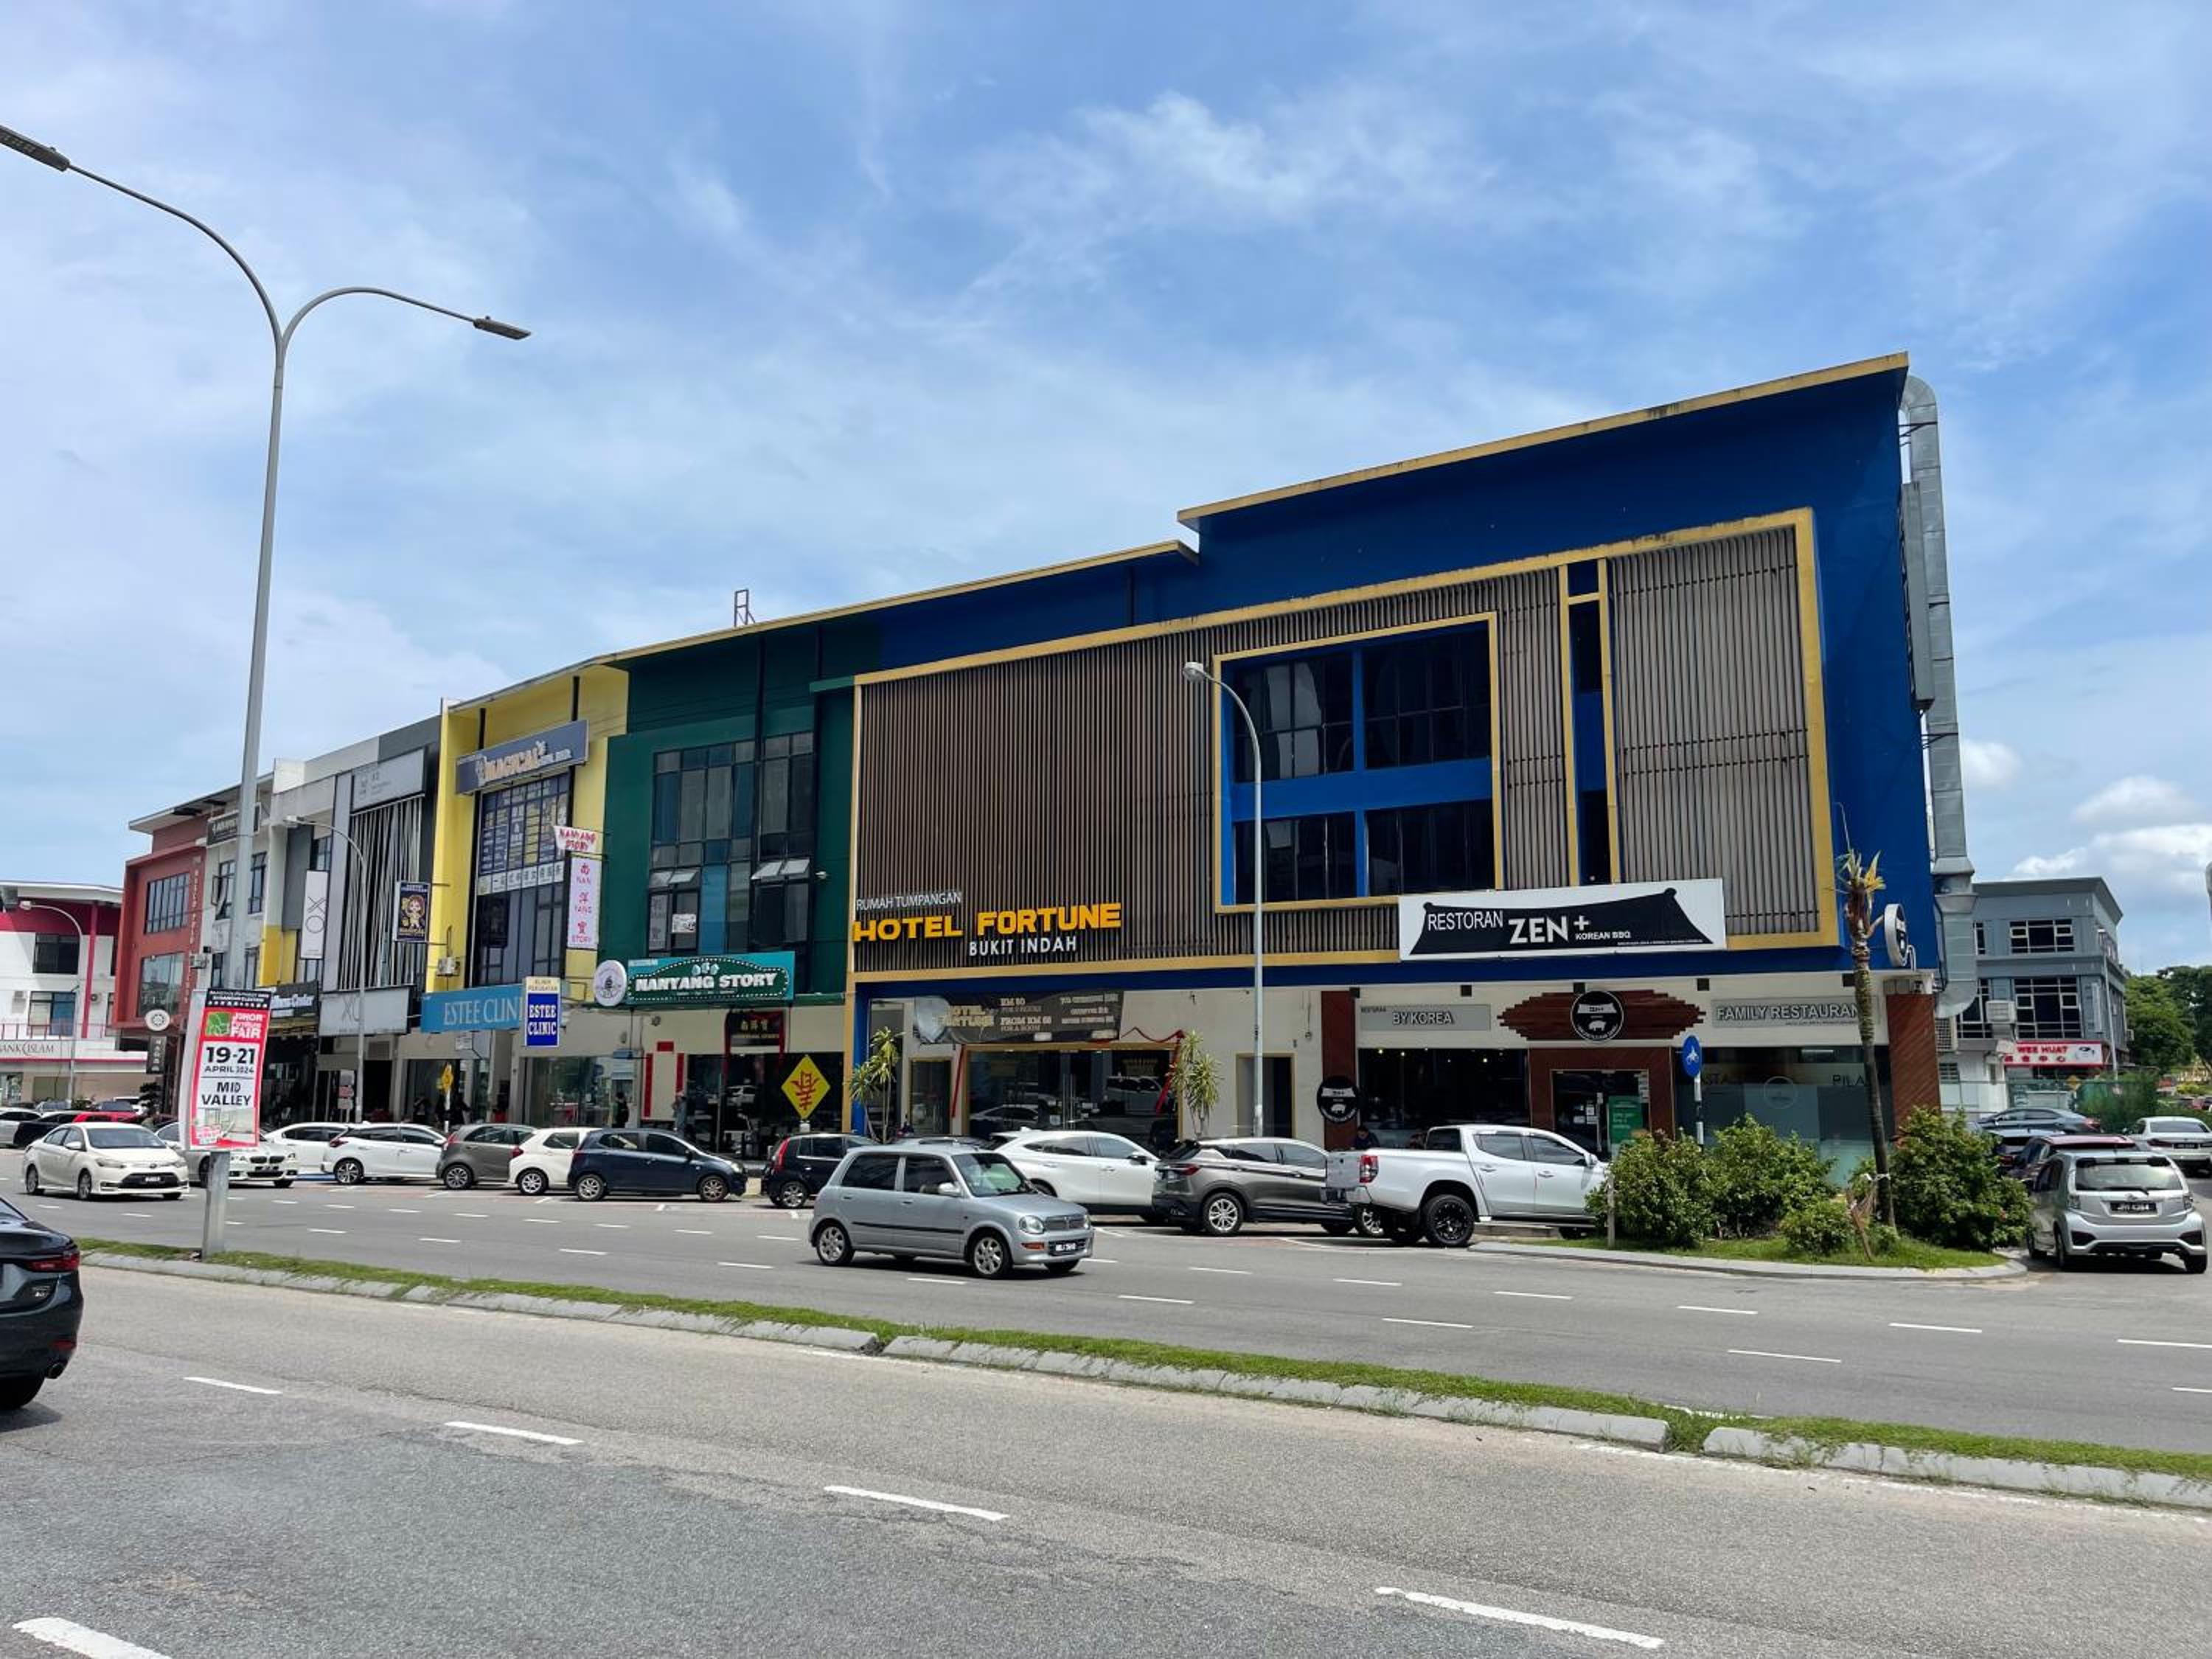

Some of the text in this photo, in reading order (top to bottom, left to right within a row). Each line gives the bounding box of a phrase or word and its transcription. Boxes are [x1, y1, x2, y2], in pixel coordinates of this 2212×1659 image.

[856, 891, 961, 911] RUMAH TUMPANGAN
[852, 902, 1121, 942] HOTEL FORTUNE
[1427, 911, 1503, 931] RESTORAN
[1575, 931, 1610, 940] KOREAN
[969, 936, 1077, 956] BUKIT INDAH
[635, 975, 714, 991] NANYANG
[719, 973, 778, 987] STORY
[444, 998, 524, 1026] ESTEE CLINI
[529, 1004, 557, 1018] ESTEE
[1717, 1002, 1858, 1021] FAMILY RESTAURAN
[230, 1026, 262, 1039] FAIR
[528, 1021, 557, 1035] CLINIC
[206, 1046, 256, 1064] 19-21
[204, 1065, 235, 1073] APRIL
[217, 1081, 241, 1093] MID
[201, 1093, 251, 1106] VALLEY
